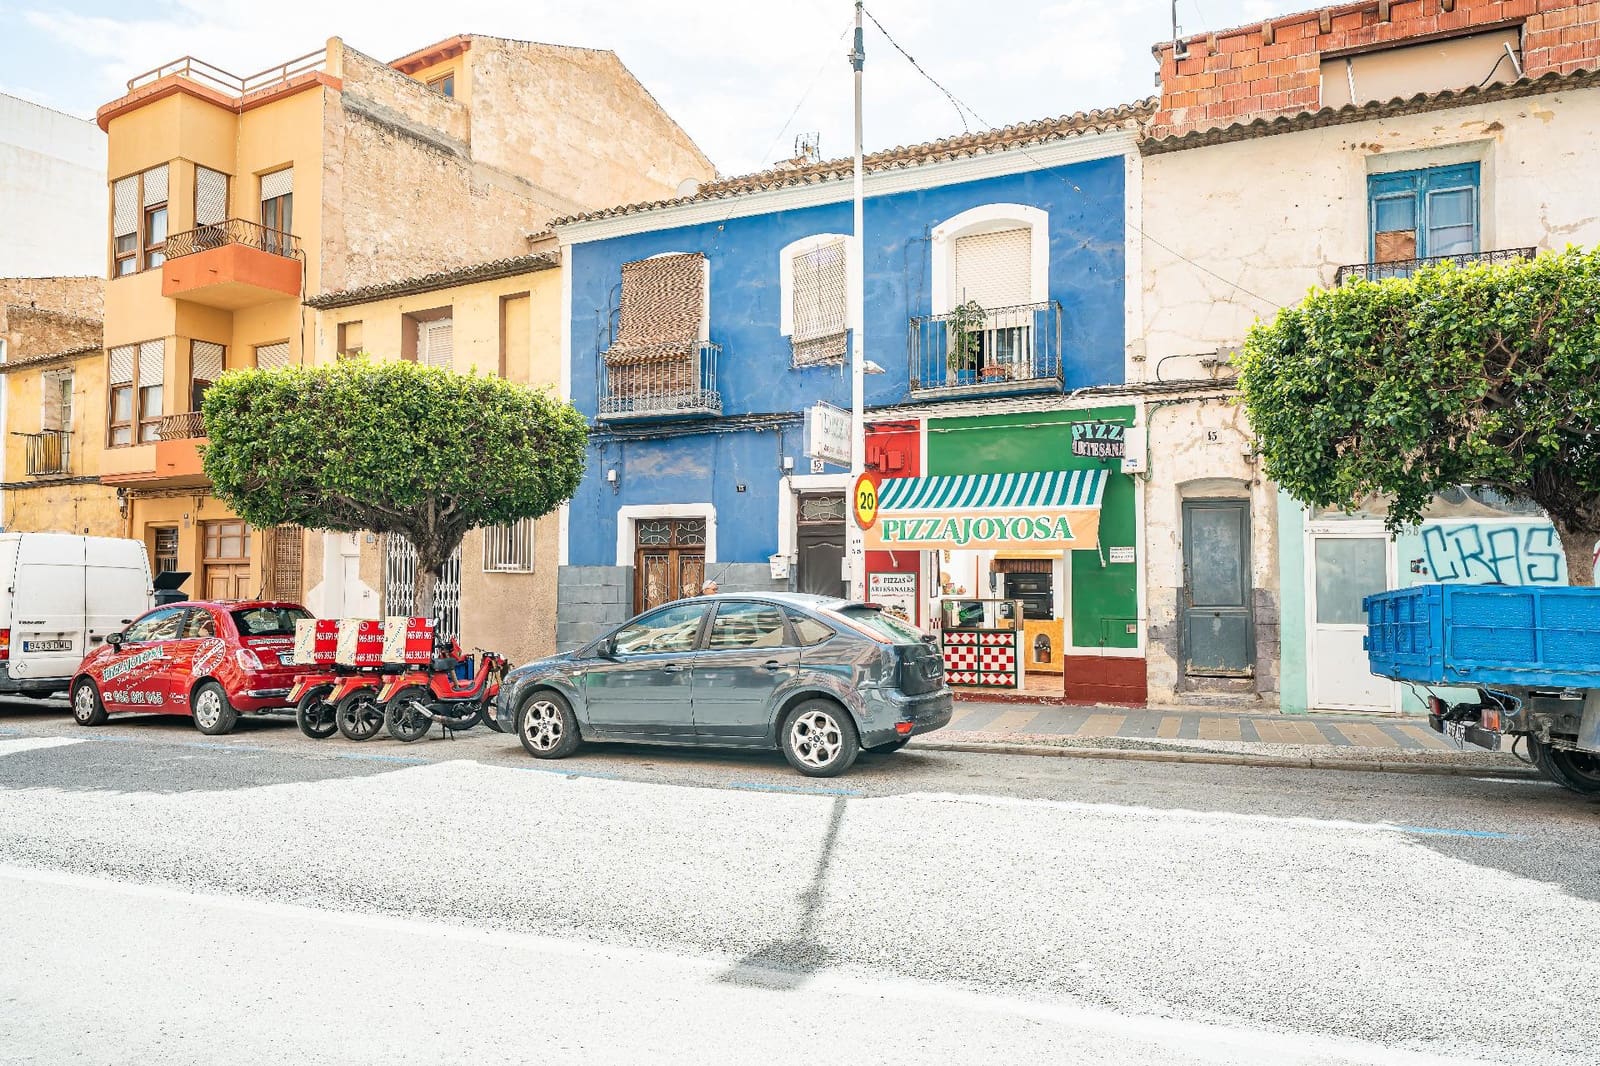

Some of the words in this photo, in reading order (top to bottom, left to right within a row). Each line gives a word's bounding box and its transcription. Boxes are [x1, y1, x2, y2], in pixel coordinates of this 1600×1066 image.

[860, 492, 874, 510] 20
[881, 516, 1074, 545] PIZZAJOYOSA
[1422, 524, 1560, 586] CRAS
